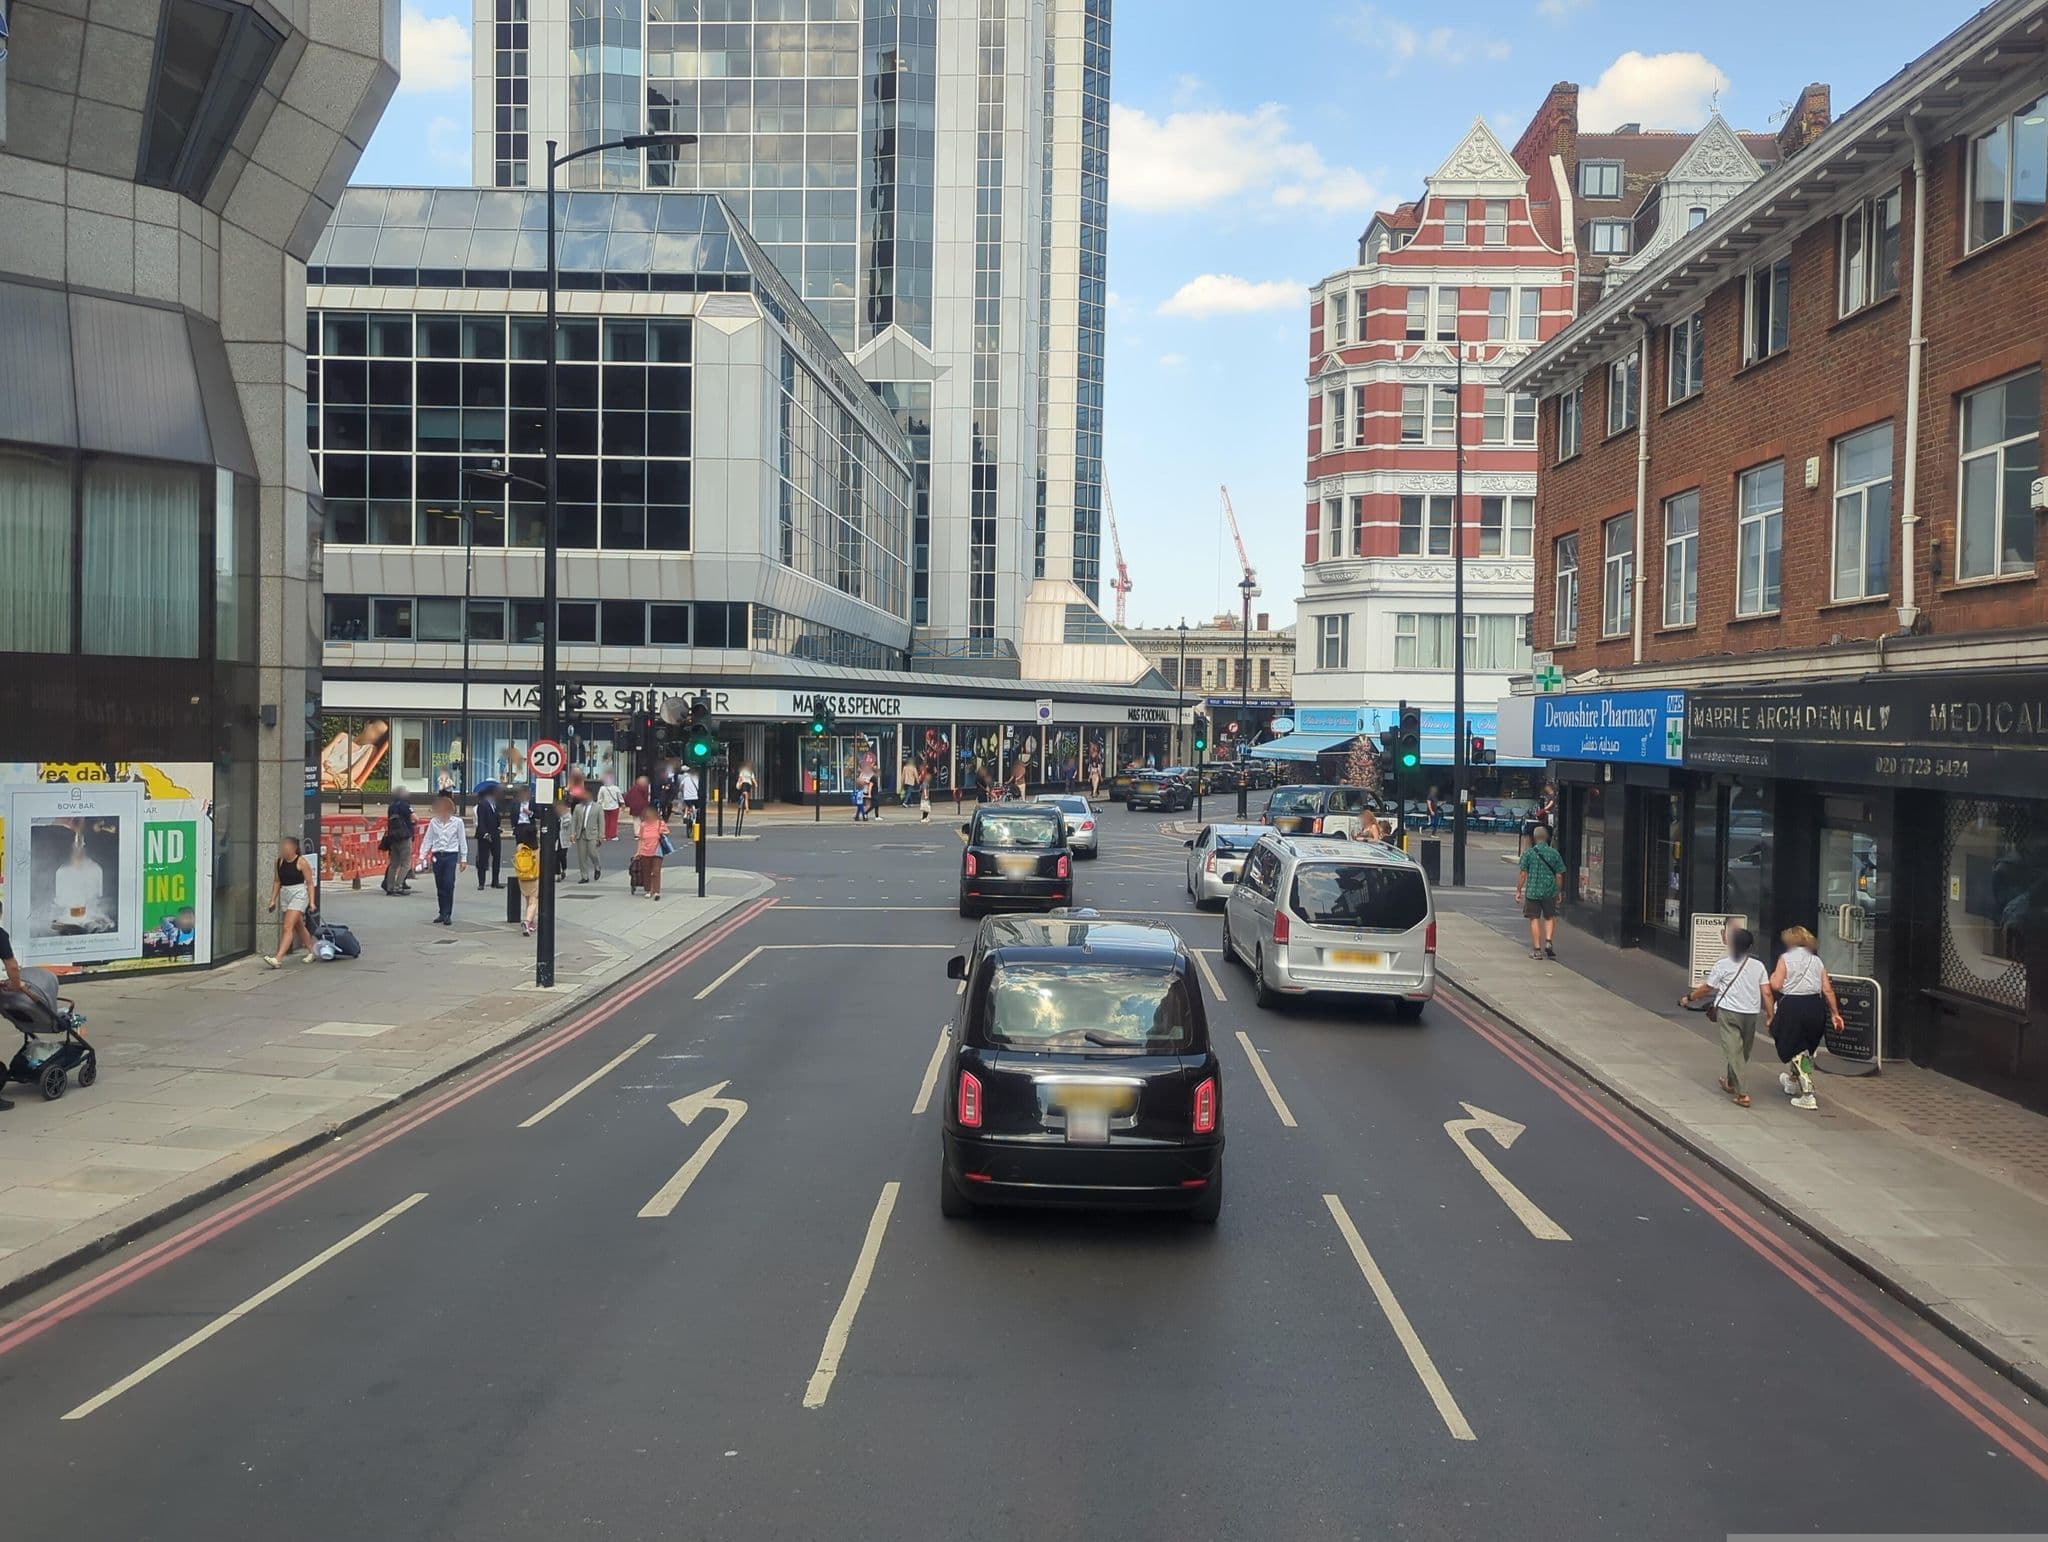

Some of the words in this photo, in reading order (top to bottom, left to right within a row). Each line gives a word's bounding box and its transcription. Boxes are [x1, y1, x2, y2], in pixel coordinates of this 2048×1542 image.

[503, 687, 587, 710] MAS
[593, 690, 608, 709] &
[614, 690, 729, 711] SPER
[792, 694, 837, 713] MAKS
[838, 696, 847, 714] &
[848, 697, 900, 716] SPENCER
[1667, 695, 1684, 712] NHS
[1141, 708, 1170, 722] FOODHALL
[1544, 700, 1599, 728] Devonshire
[1600, 698, 1657, 738] Pharmacy
[1693, 705, 1751, 729] MARBLE
[1755, 705, 1801, 731] ARCH
[1805, 703, 1876, 731] DENTAL
[1929, 701, 2048, 734] MEDICAL
[534, 751, 560, 766] 20
[1875, 757, 1897, 774] 020
[1900, 757, 1931, 776] 7723
[1935, 759, 1969, 778] 5424
[148, 829, 184, 865] ND
[147, 874, 185, 904] ING
